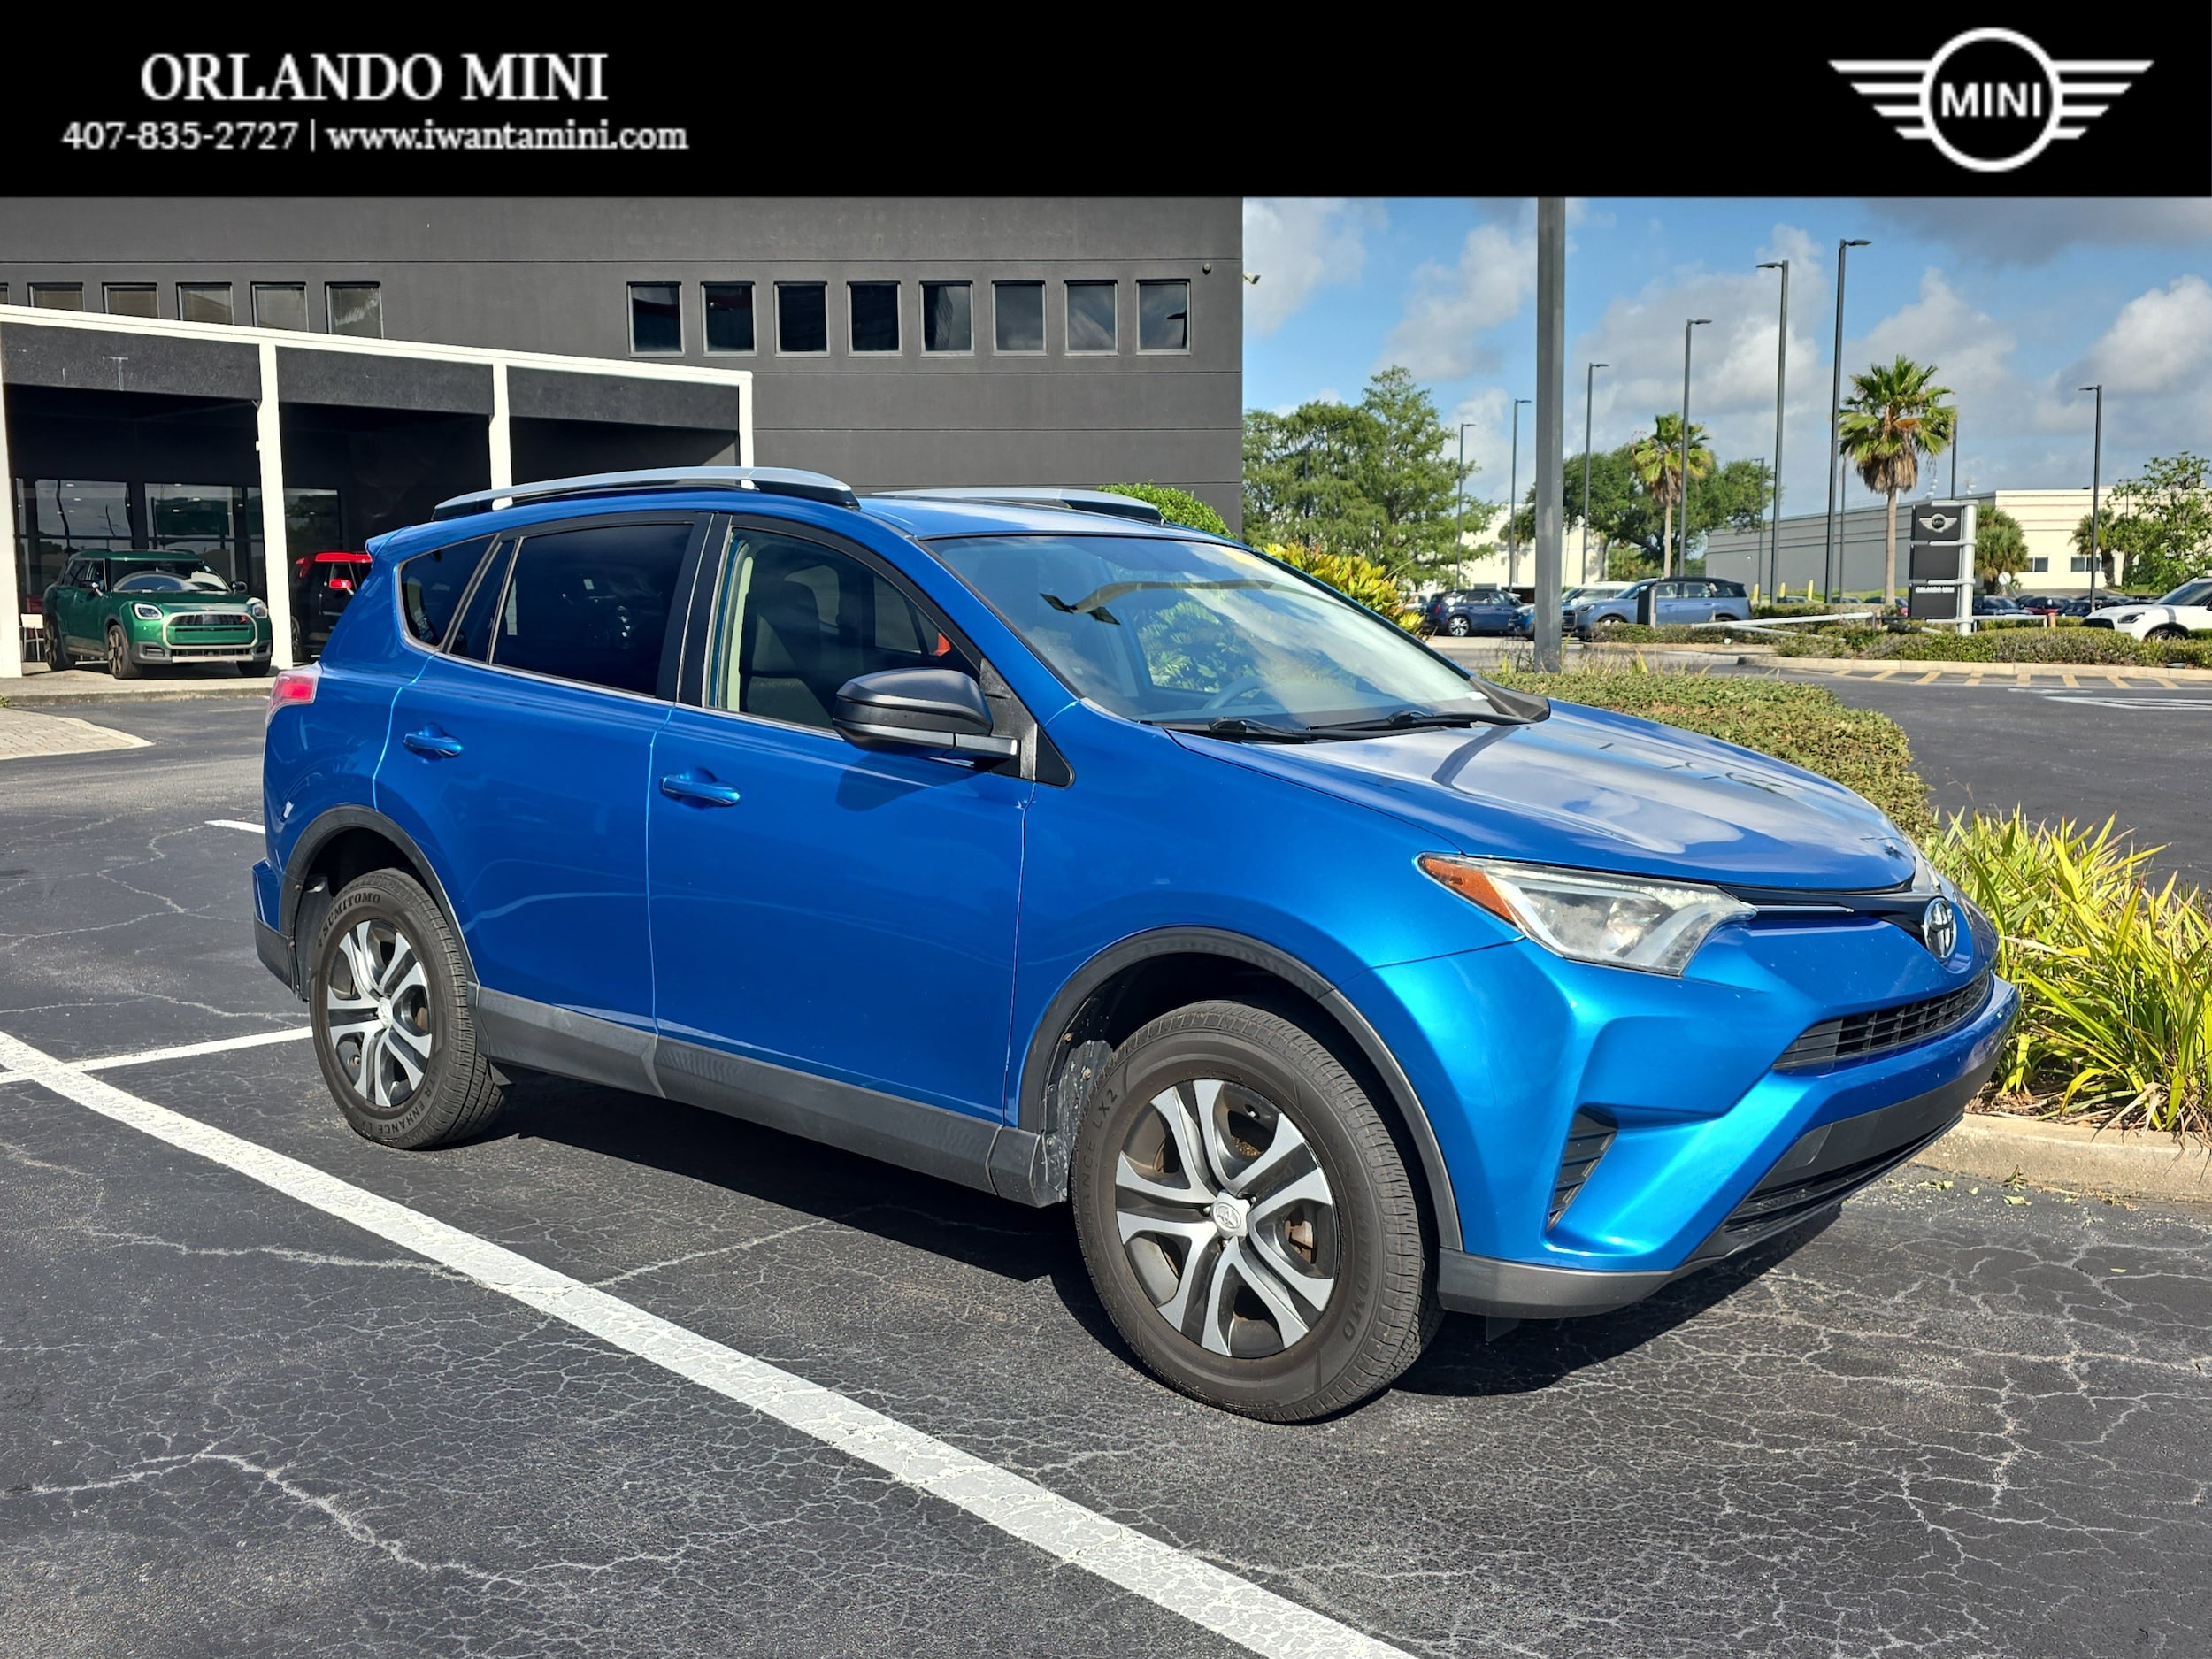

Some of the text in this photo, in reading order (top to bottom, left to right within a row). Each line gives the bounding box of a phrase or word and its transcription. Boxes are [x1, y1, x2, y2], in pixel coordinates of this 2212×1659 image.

[322, 892, 381, 938] SUMITOMO
[377, 1100, 426, 1133] ENHANCE
[1092, 1088, 1118, 1130] LX2
